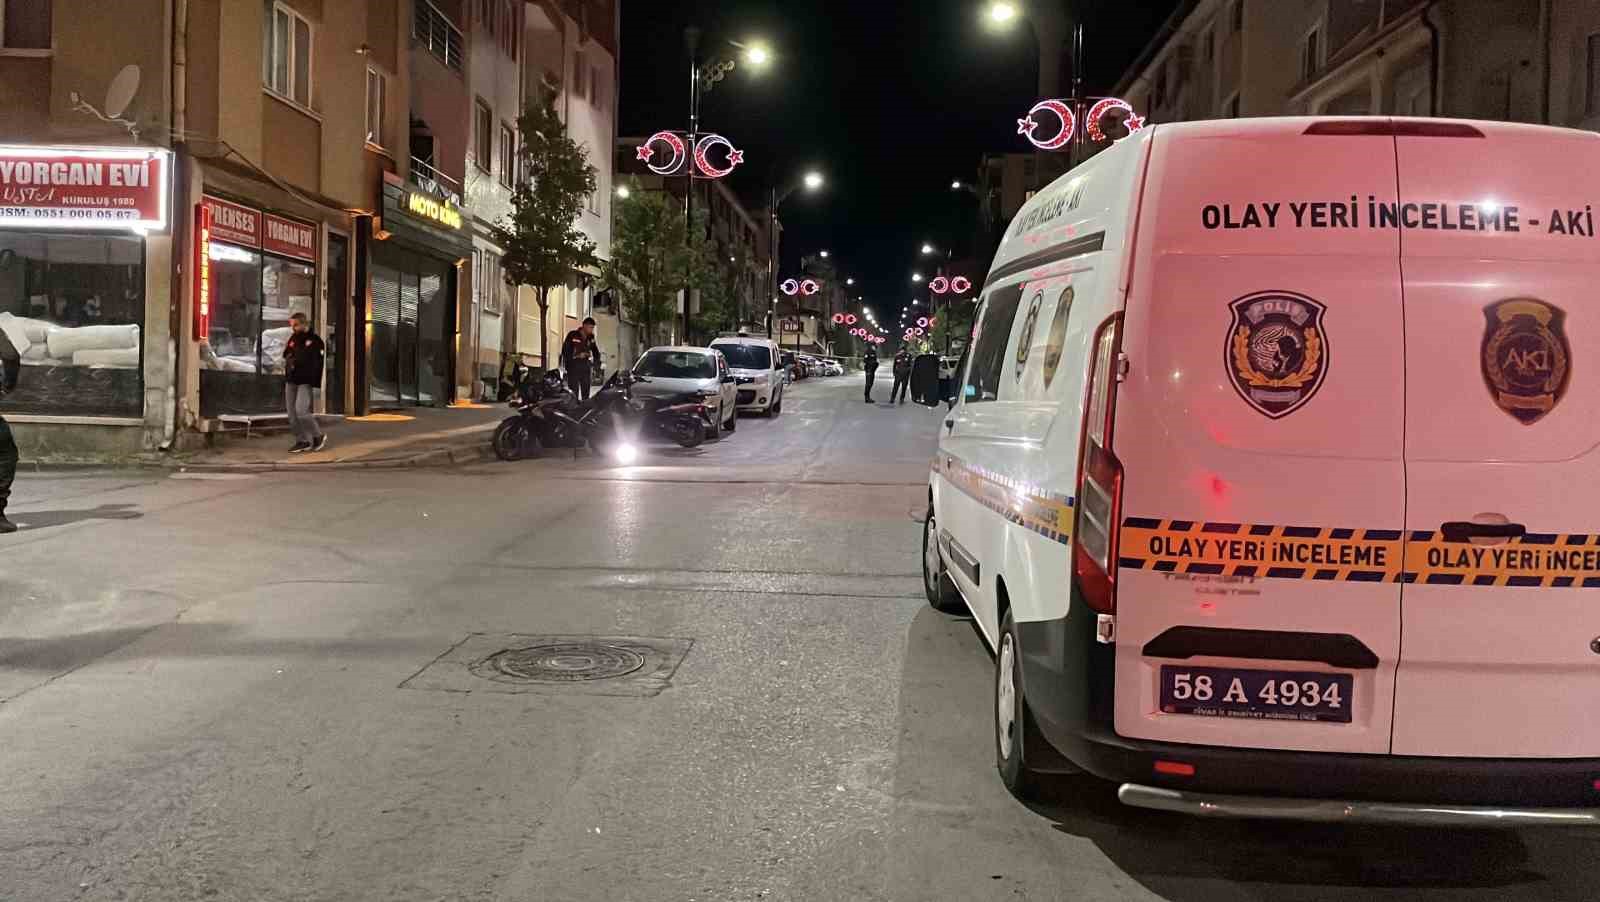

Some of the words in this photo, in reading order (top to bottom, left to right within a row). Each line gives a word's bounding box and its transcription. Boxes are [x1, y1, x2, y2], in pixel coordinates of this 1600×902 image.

[0, 161, 103, 186] YORGAN
[109, 160, 149, 187] EVİ
[410, 192, 439, 220] MOTO
[1202, 203, 1281, 229] OLAY
[1289, 195, 1358, 228] YERİ
[1368, 195, 1520, 233] İNCELEME
[1548, 205, 1595, 238] AKİ
[267, 220, 299, 246] YORGAN
[1150, 535, 1208, 557] OLAY
[1427, 547, 1486, 569] OLAY
[1173, 672, 1214, 701] 58
[1223, 677, 1249, 704] A
[1258, 679, 1343, 708] 4934
